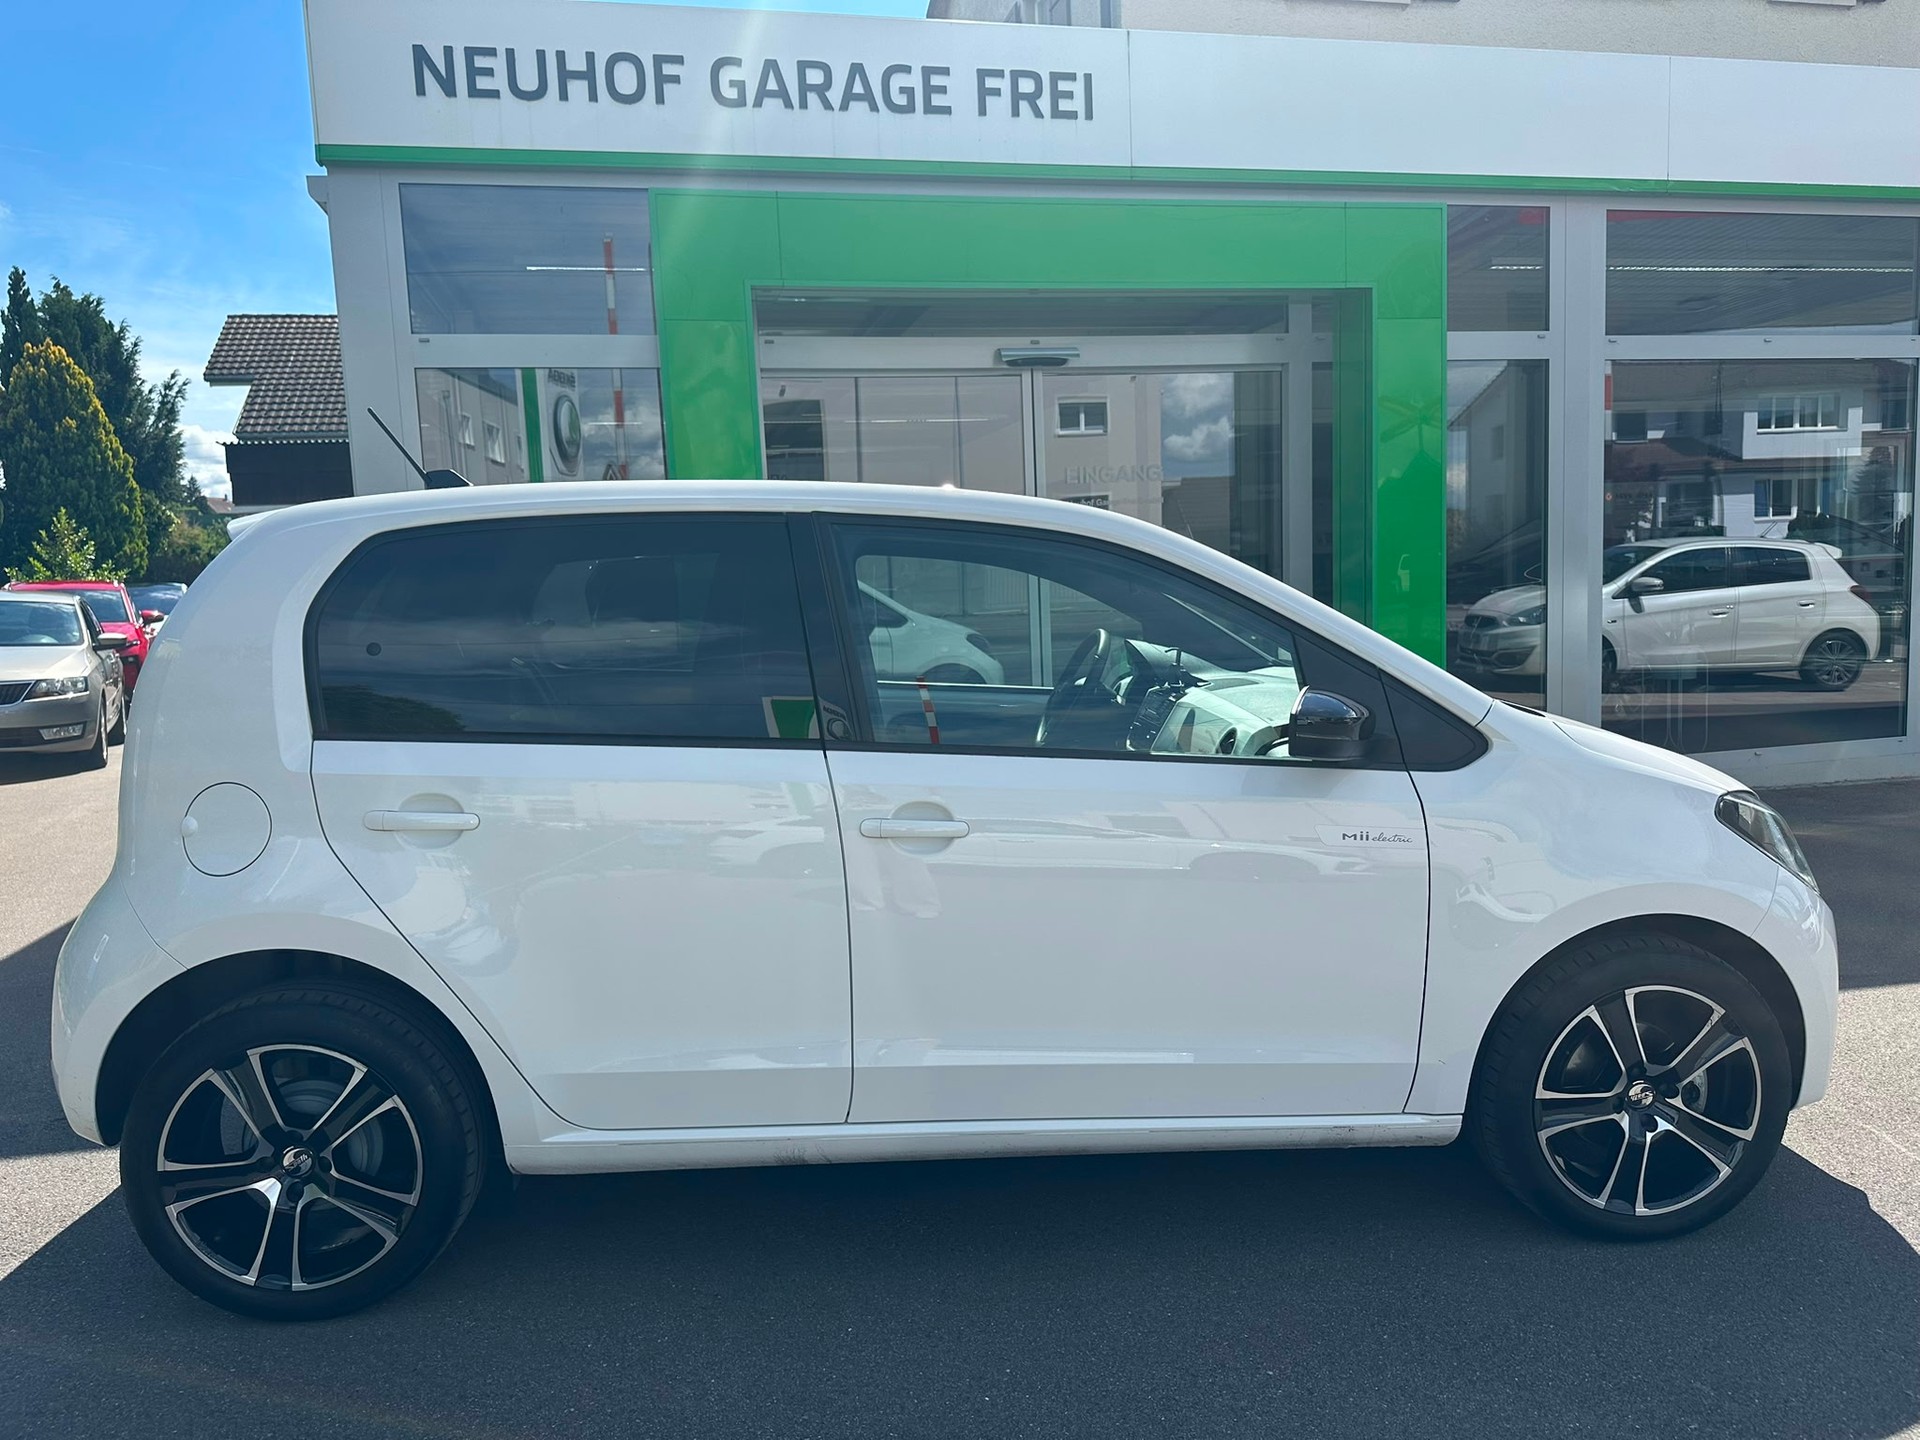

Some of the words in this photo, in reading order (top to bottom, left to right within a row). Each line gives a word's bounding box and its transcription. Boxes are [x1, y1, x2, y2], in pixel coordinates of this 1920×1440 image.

[411, 43, 685, 105] NEUHOF
[709, 56, 953, 116] GARAGE
[975, 67, 1094, 121] FREI
[1064, 464, 1163, 484] EINGANG
[1342, 830, 1370, 841] Mii
[1371, 832, 1413, 843] electric
